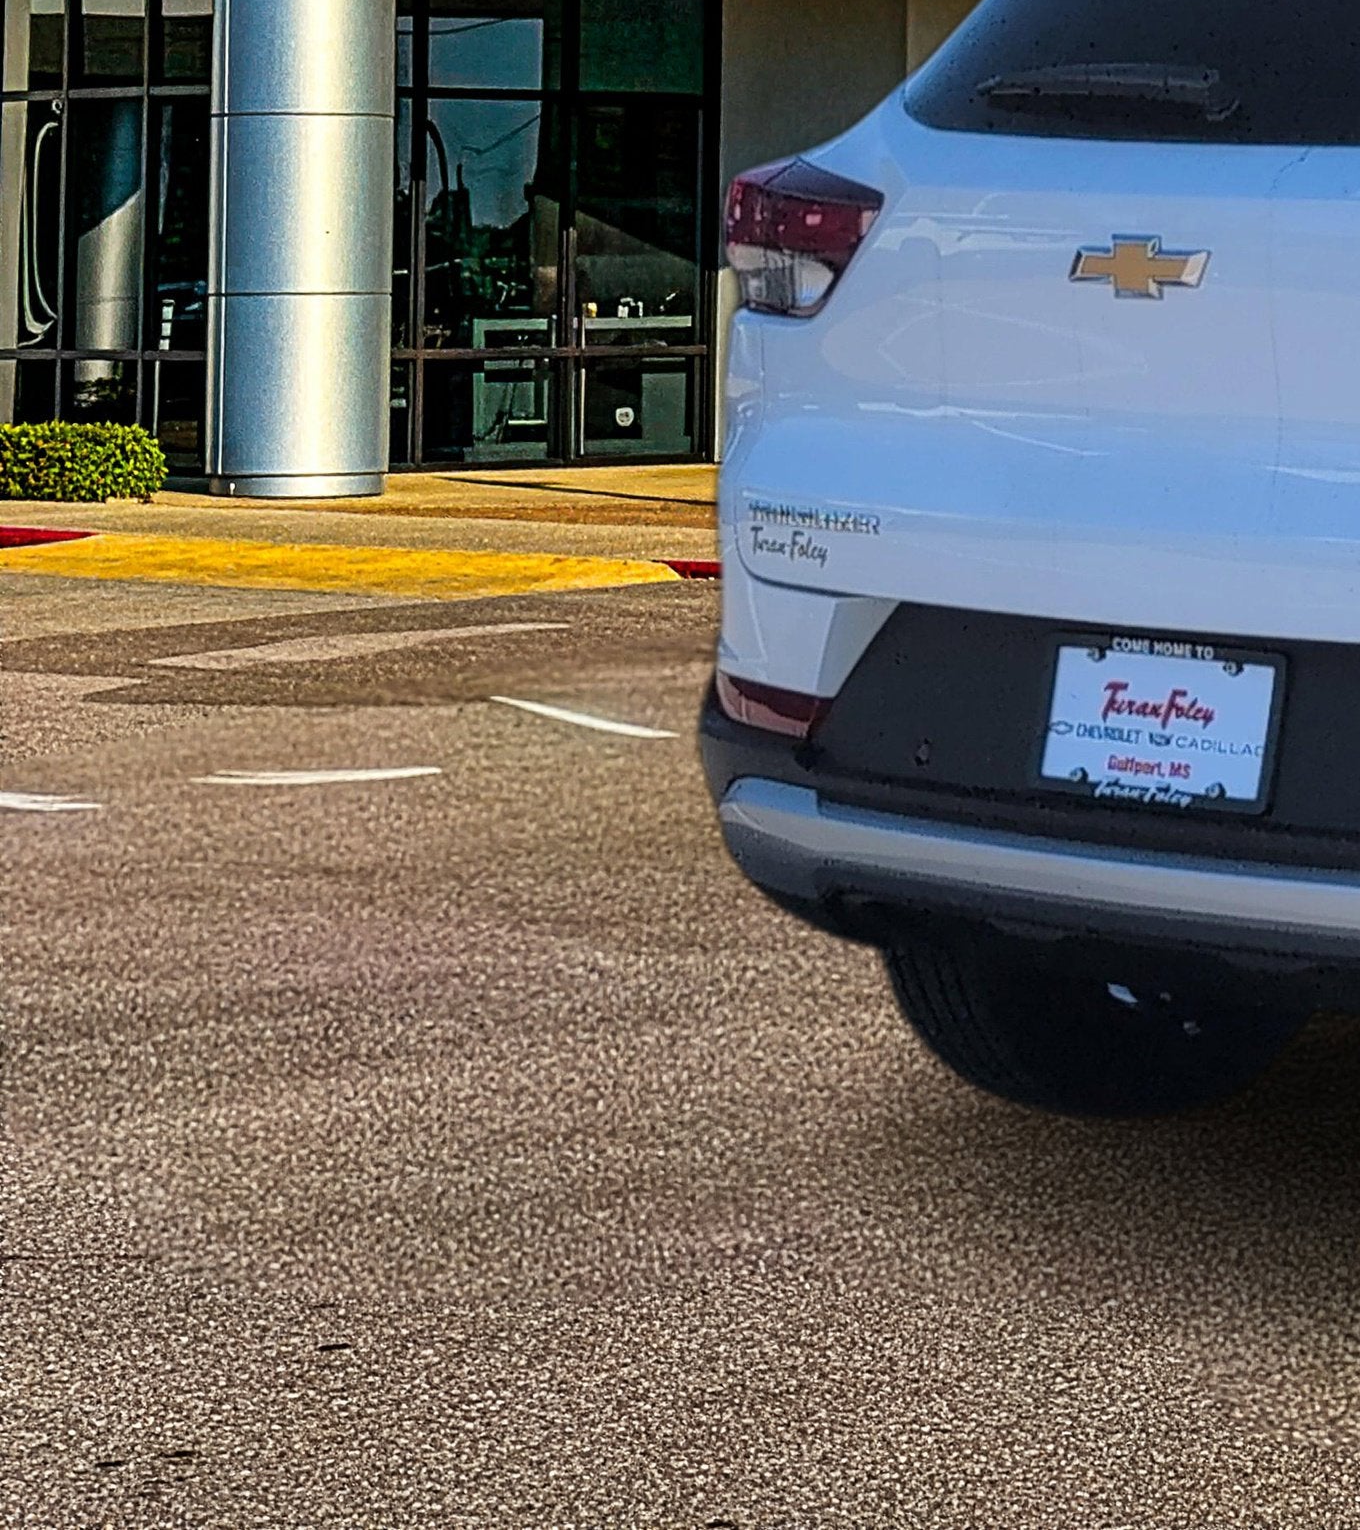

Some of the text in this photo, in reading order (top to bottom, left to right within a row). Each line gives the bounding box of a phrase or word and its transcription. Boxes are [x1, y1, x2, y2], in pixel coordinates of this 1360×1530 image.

[1112, 636, 1215, 660] COME HOME TO
[1101, 680, 1216, 730] Turan Foley
[1076, 722, 1264, 758] CHEVROLET CADILLAC
[1169, 761, 1191, 780] MS
